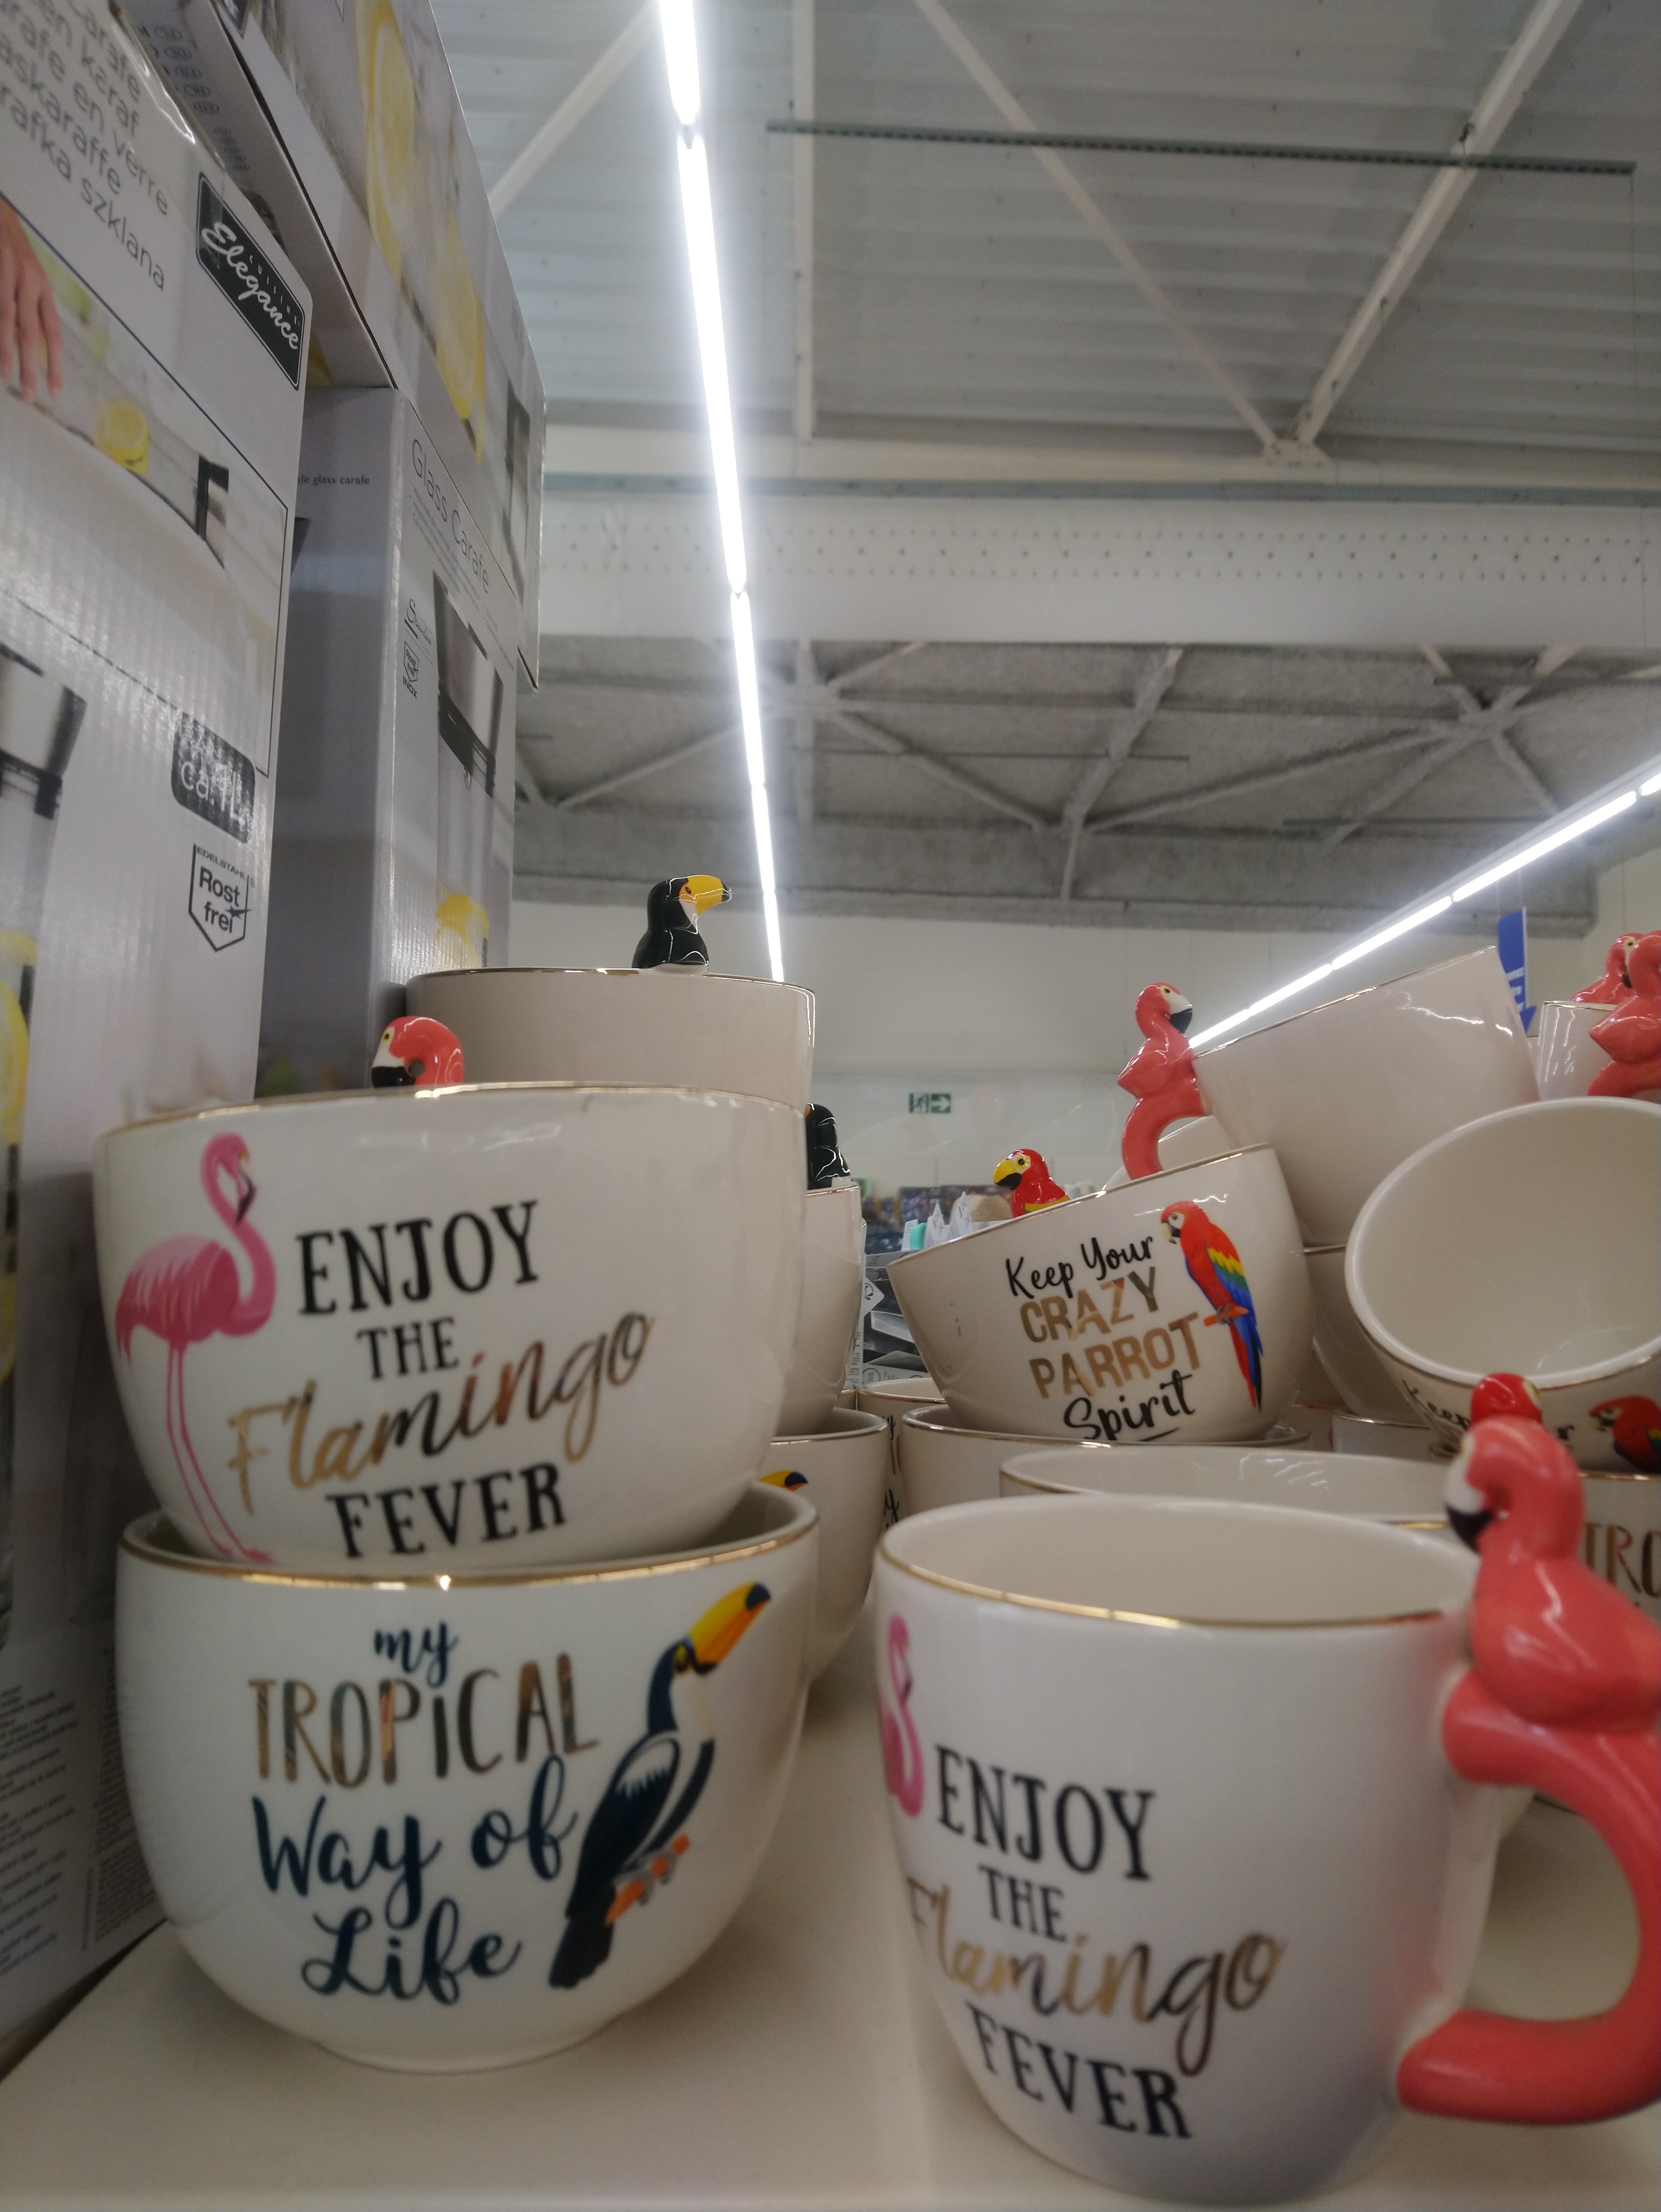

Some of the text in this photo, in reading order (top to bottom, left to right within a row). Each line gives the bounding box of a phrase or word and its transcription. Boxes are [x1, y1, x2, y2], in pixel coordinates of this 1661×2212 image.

[73, 81, 105, 135] en
[112, 129, 168, 216] verre
[80, 178, 164, 291] szklana
[201, 222, 298, 350] Elegance
[313, 474, 336, 486] glass
[339, 475, 370, 485] carafe
[412, 439, 447, 522] Glass
[452, 509, 489, 594] Carafe
[402, 675, 418, 700] INOX
[197, 846, 247, 881] EDELSTAHL
[199, 866, 240, 907] Rost
[204, 900, 233, 934] frei
[295, 1199, 540, 1316] ENJOY
[1005, 1235, 1154, 1299] Keep Your
[356, 1316, 459, 1380] THE
[1019, 1266, 1158, 1344] CRAZY
[1029, 1312, 1200, 1399] PARROT
[228, 1310, 656, 1516] Flamingo
[1063, 1369, 1196, 1441] Spirit
[325, 1461, 567, 1559] FEVER
[373, 1621, 459, 1688] my
[252, 1794, 442, 1930] Way
[471, 1754, 578, 1881] of
[934, 1744, 1155, 1882] ENJOY
[978, 1864, 1067, 1943] THE
[301, 1897, 521, 2004] Life
[907, 1876, 1286, 2077] Flamingo
[966, 2000, 1192, 2138] FEVER
